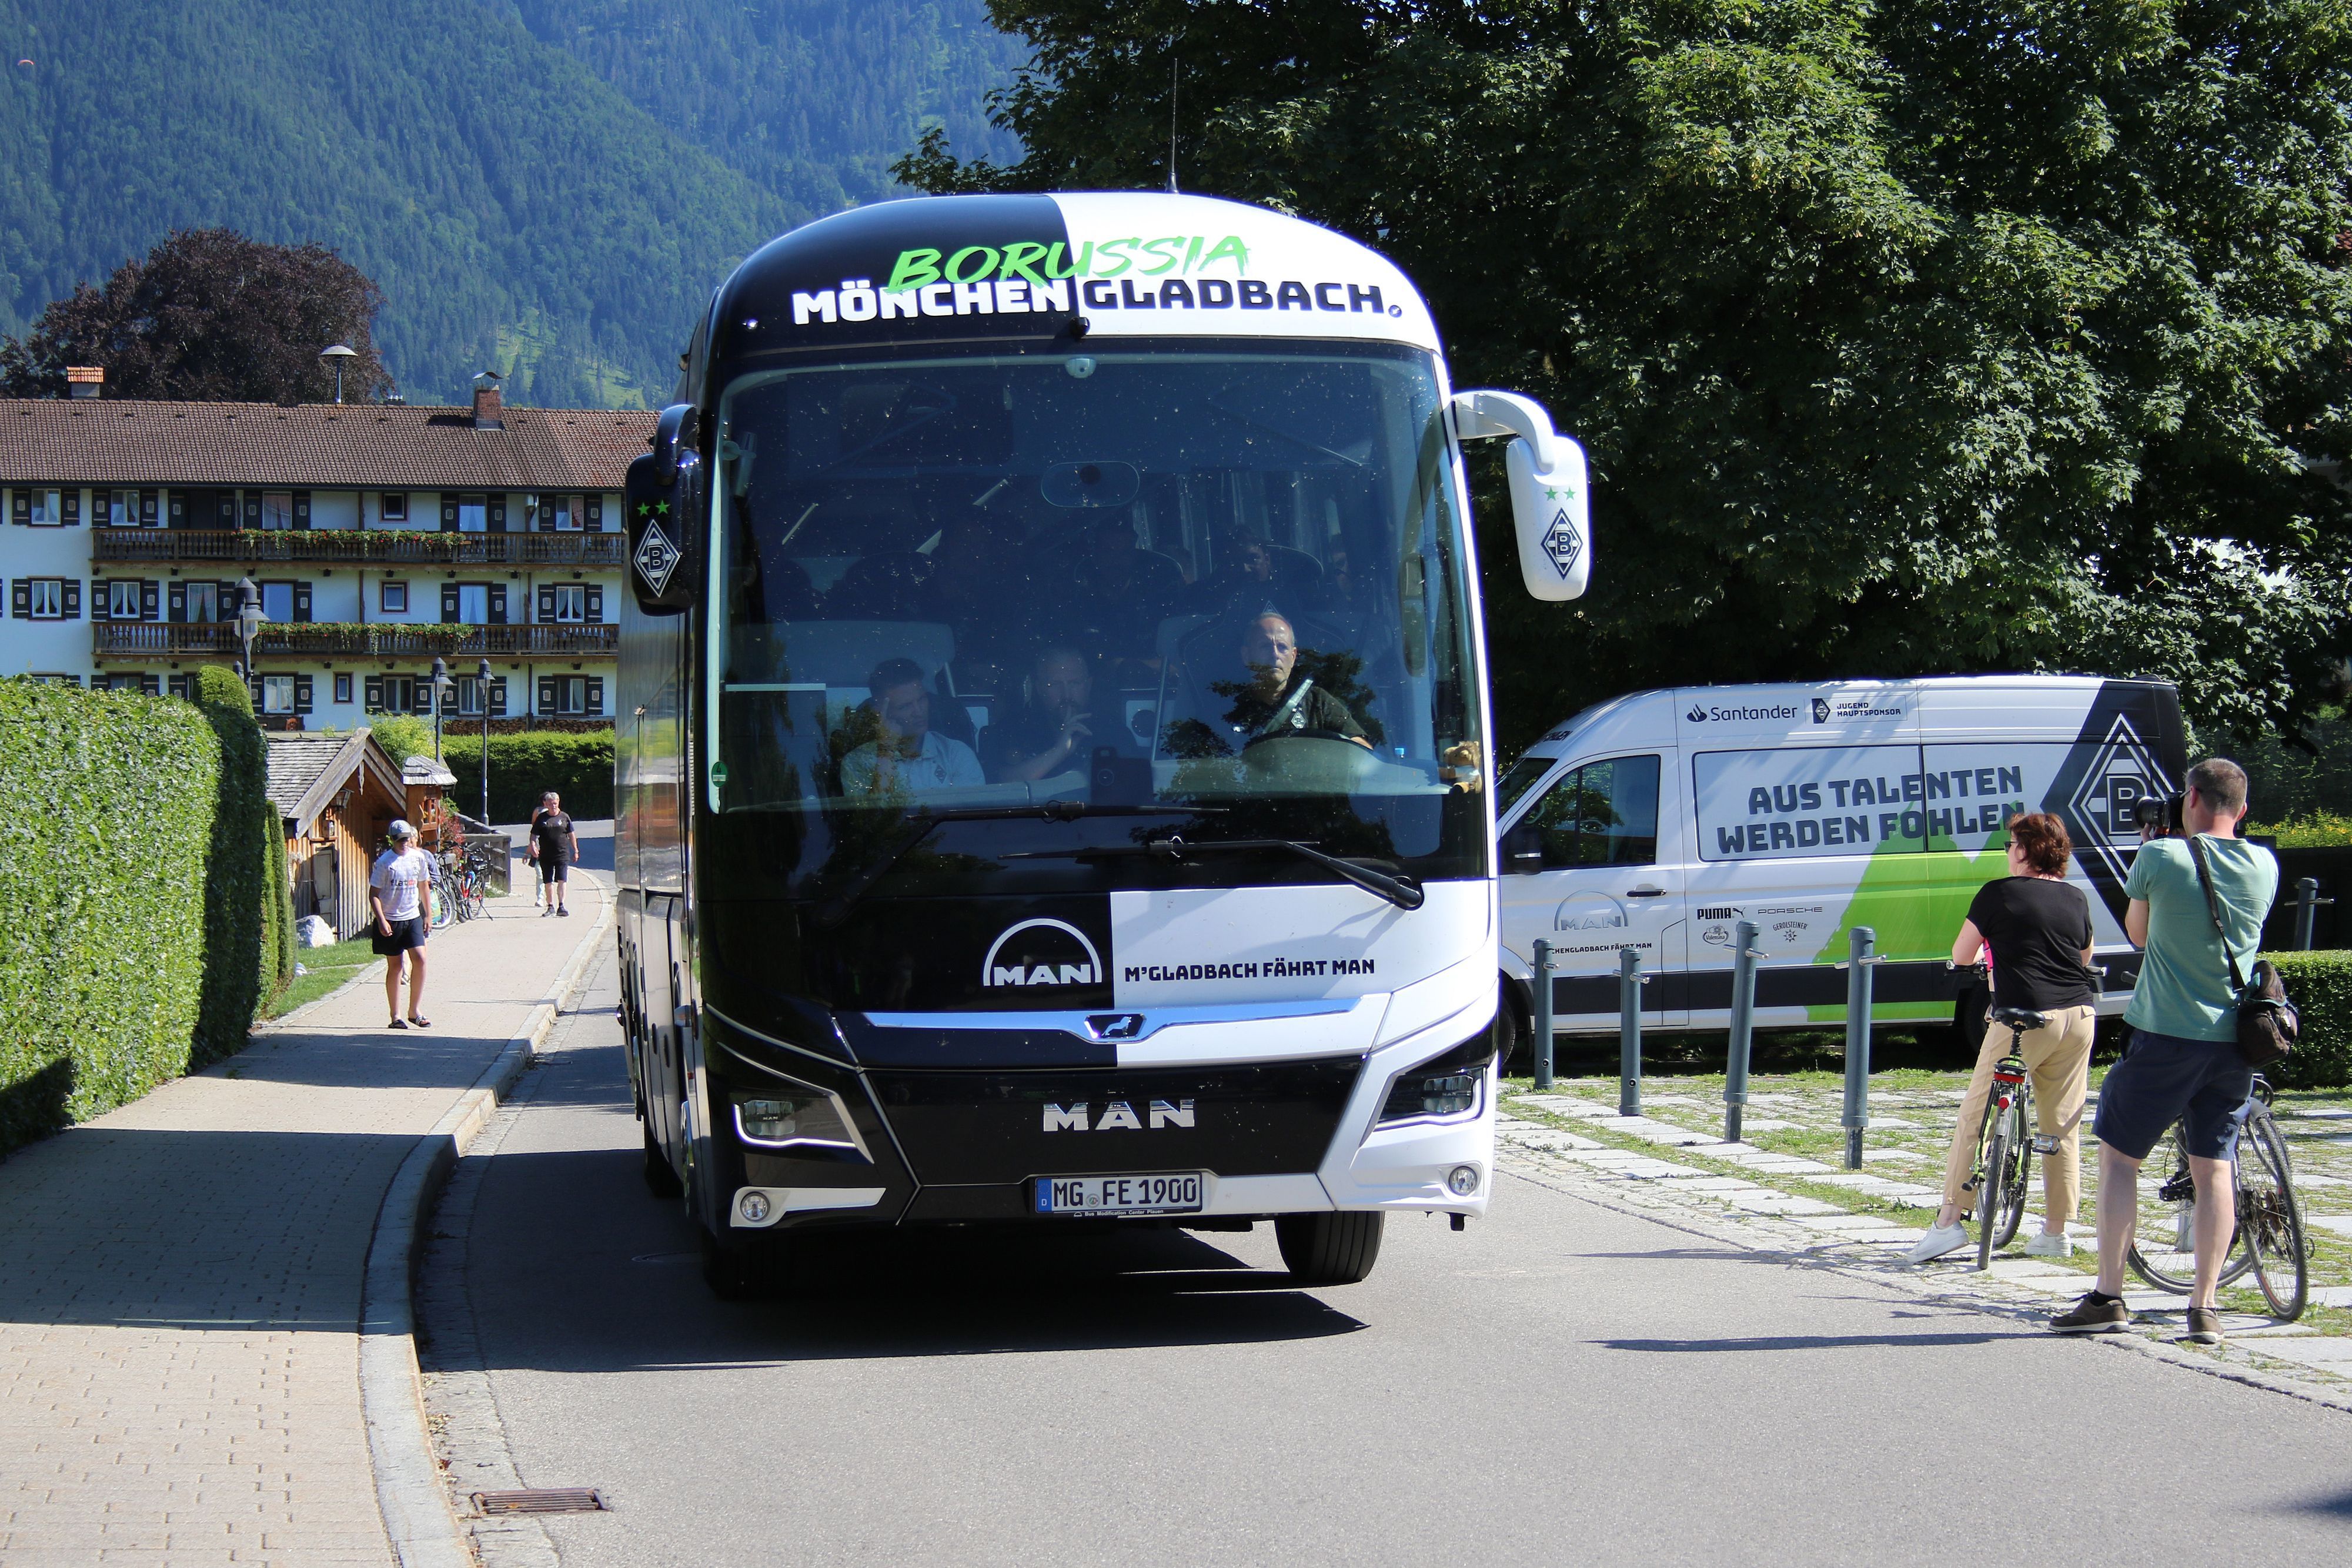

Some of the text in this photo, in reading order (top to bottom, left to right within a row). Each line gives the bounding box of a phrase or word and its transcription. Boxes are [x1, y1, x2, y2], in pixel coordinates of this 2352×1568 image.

[884, 235, 1251, 293] BORUSSIA
[1710, 705, 1798, 721] Santander
[1837, 709, 1901, 717] HAUPTSPONSOR
[1748, 766, 2022, 815] AUS TALENTEN
[1717, 815, 1870, 854] WERDEN
[1561, 916, 1621, 931] MAN
[1697, 908, 1732, 920] PUMA
[1773, 921, 1808, 931] GEROLSTEINER
[994, 964, 1091, 986] MAN
[1125, 958, 1375, 982] M'GLADBACH FÄHRT MAN
[1043, 1099, 1195, 1132] MAN
[1041, 1198, 1047, 1206] D
[1053, 1178, 1196, 1207] MG FE 1900
